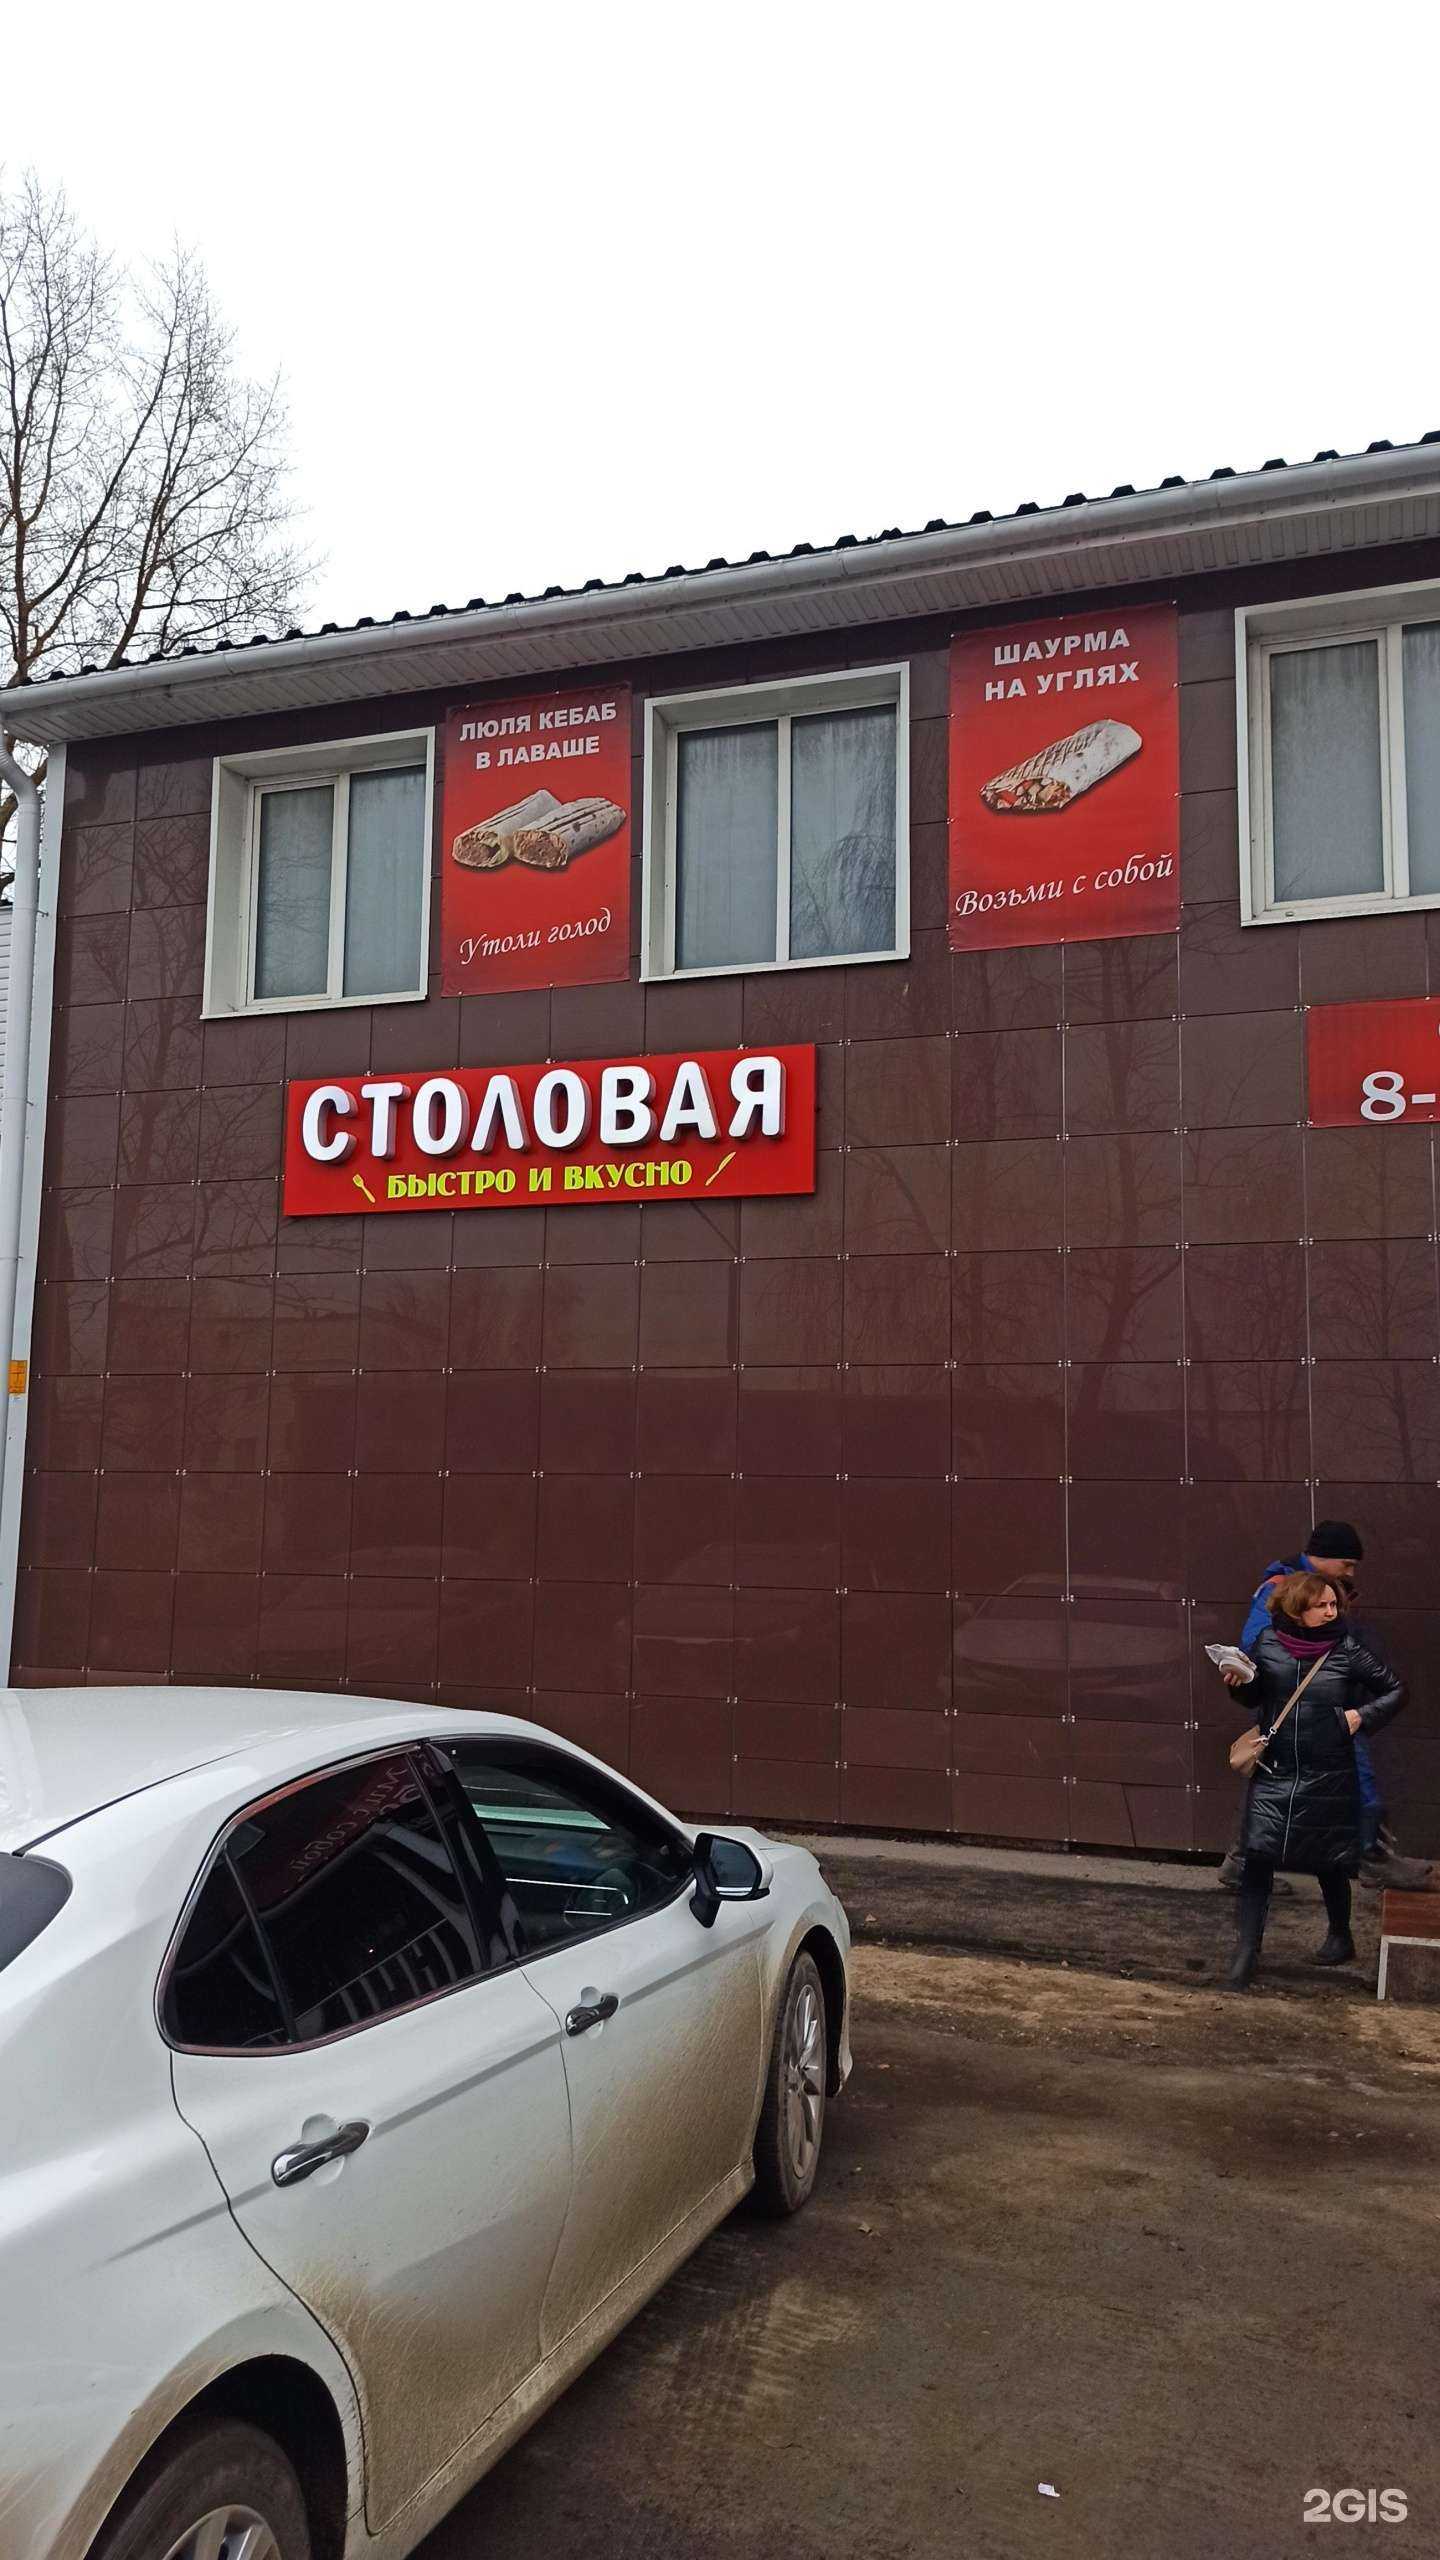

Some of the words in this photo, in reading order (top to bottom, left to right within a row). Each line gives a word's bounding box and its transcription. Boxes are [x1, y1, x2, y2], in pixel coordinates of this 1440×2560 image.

[994, 628, 1130, 666] ШАУРМА
[985, 678, 1027, 701] НА
[1037, 661, 1140, 695] УГЛЯХ
[460, 715, 530, 742] ЛЮЛЯ
[539, 702, 617, 730] КЕБАБ
[476, 752, 491, 770] В
[497, 736, 600, 768] ЛАВАШЕ
[955, 880, 1063, 917] Возьми
[1072, 875, 1086, 894] с
[1094, 853, 1174, 890] собой
[460, 929, 541, 965] Утоли
[548, 907, 612, 943] голод
[302, 1056, 786, 1163] СТОЛОВАЯ
[387, 1168, 516, 1199] БЫСТРО
[528, 1164, 552, 1193] И
[563, 1159, 692, 1191] ВКУСНО
